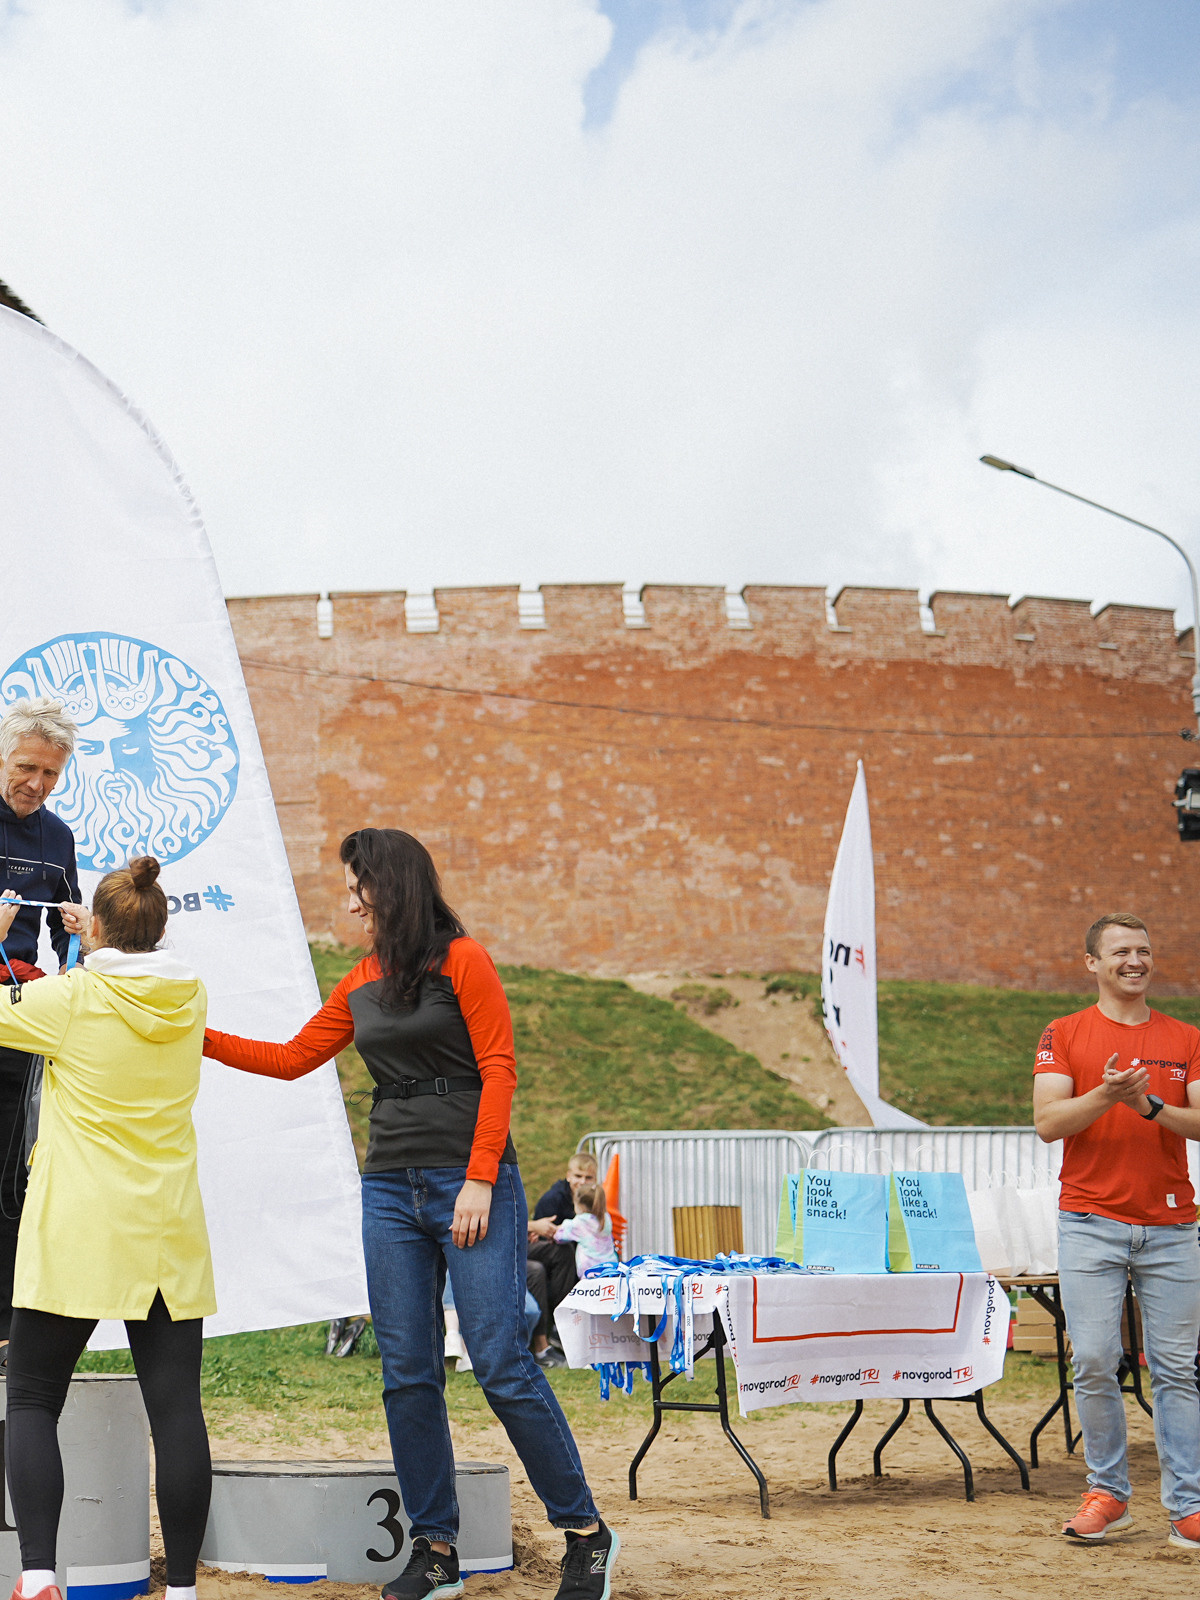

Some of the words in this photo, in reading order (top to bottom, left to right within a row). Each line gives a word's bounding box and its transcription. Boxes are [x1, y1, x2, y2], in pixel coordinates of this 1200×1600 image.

[1130, 1057, 1188, 1070] #novgorod
[807, 1174, 831, 1187] You
[897, 1176, 920, 1187] You
[807, 1185, 833, 1198] look
[899, 1186, 923, 1198] look
[807, 1196, 828, 1208] like
[830, 1200, 838, 1209] a
[901, 1196, 921, 1208] like
[922, 1200, 929, 1208] a
[806, 1208, 847, 1220] snack!
[903, 1208, 938, 1219] snack!
[366, 1488, 404, 1563] 3
